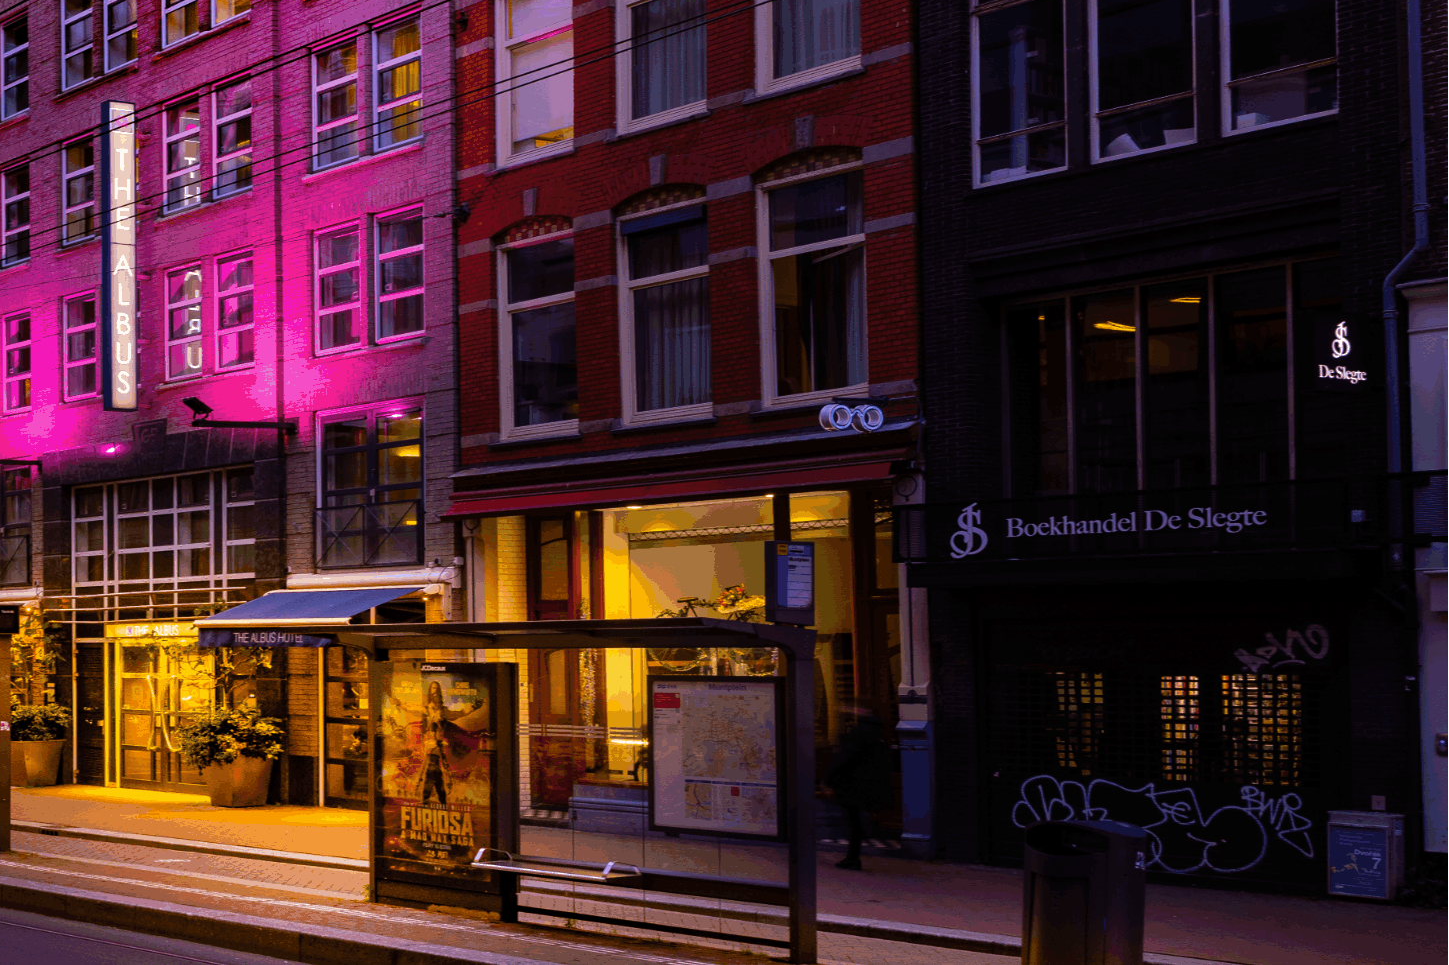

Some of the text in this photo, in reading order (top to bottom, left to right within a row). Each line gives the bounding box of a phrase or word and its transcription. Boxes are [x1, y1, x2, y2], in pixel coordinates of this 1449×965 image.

[113, 148, 132, 394] THE ALBUS
[1318, 364, 1367, 384] De Slegte
[1006, 506, 1268, 538] Boekhandel De Slegte
[134, 624, 179, 636] THE ALBUS
[233, 632, 304, 643] THE ALBUS HOTEL
[708, 683, 747, 692] Muntplein
[400, 806, 474, 837] FURIOSA
[400, 830, 474, 847] A MAD MAX SAGA
[1372, 857, 1382, 870] 7
